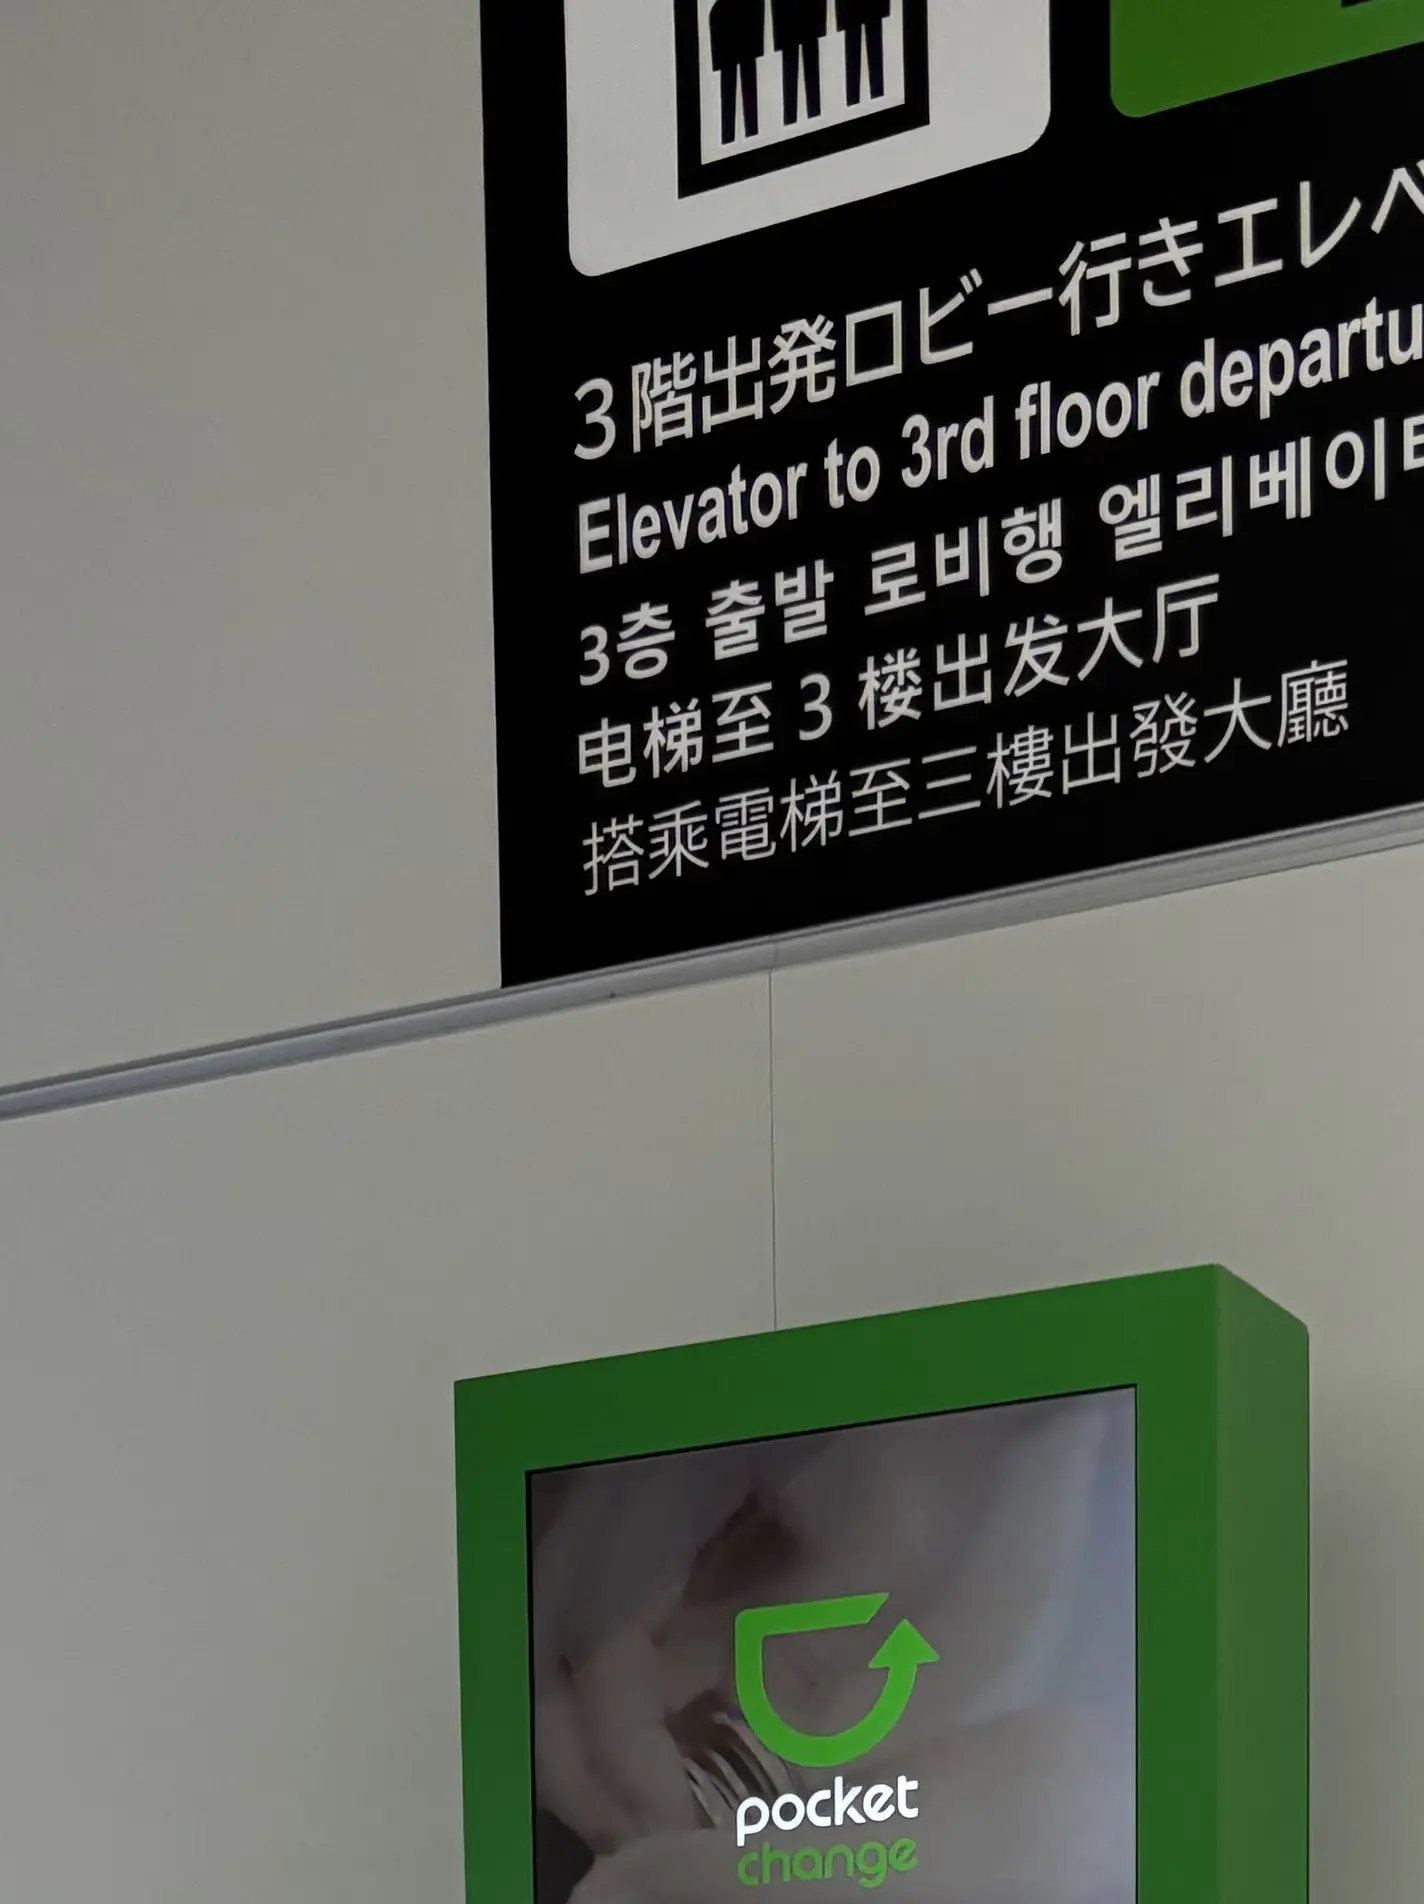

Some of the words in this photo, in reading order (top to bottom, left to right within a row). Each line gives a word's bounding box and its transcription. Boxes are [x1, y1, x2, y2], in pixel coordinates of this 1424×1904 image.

[578, 468, 807, 574] Elevator
[823, 435, 882, 506] to
[899, 396, 996, 489] 3rd
[1015, 362, 1163, 463] floor
[578, 602, 677, 688] 3층
[703, 555, 836, 662] 출발
[863, 500, 1066, 618] 로비행
[581, 656, 1352, 898] 搭乘電梯至三樓出發大廳
[737, 1774, 920, 1846] pocket
[737, 1833, 918, 1888] change
